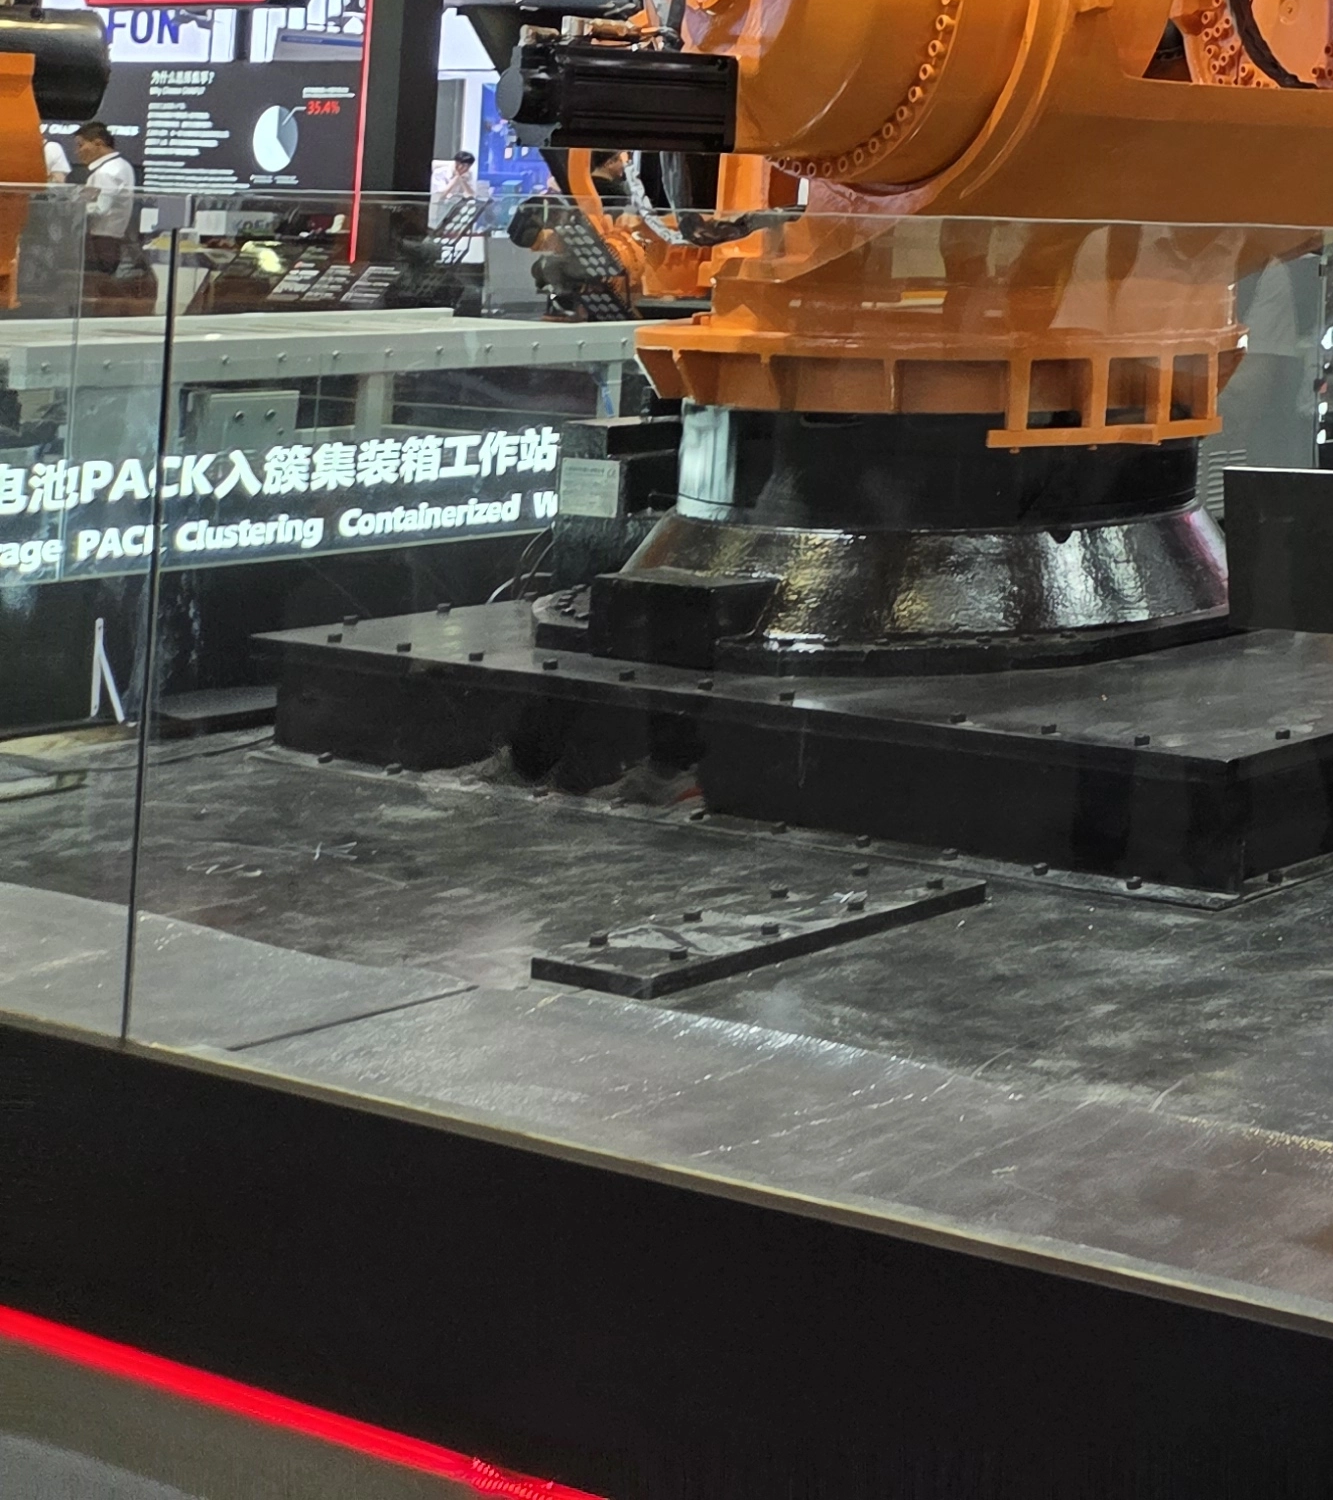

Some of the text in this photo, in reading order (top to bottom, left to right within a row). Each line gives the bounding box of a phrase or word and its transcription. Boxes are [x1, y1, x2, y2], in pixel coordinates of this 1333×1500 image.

[0, 538, 63, 573] age
[175, 514, 324, 550] Clustering
[338, 493, 522, 537] Containerized
